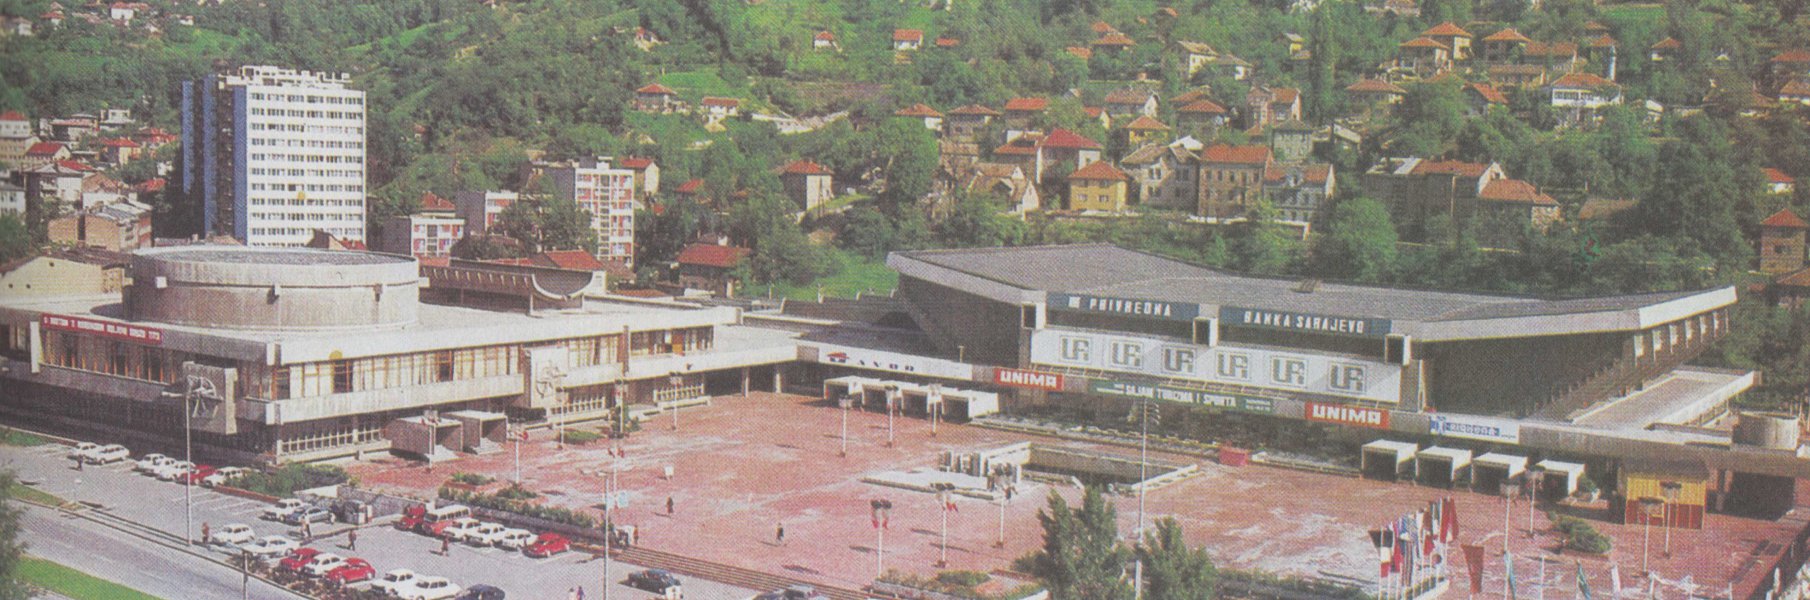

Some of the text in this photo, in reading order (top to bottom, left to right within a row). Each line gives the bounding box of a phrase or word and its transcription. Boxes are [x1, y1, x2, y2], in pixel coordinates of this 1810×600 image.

[1089, 298, 1171, 317] PRIVREDNA
[1243, 310, 1364, 334] BANKA SARAJEVO
[1000, 370, 1057, 388] UNIMA
[1313, 404, 1382, 426] UNIMA
